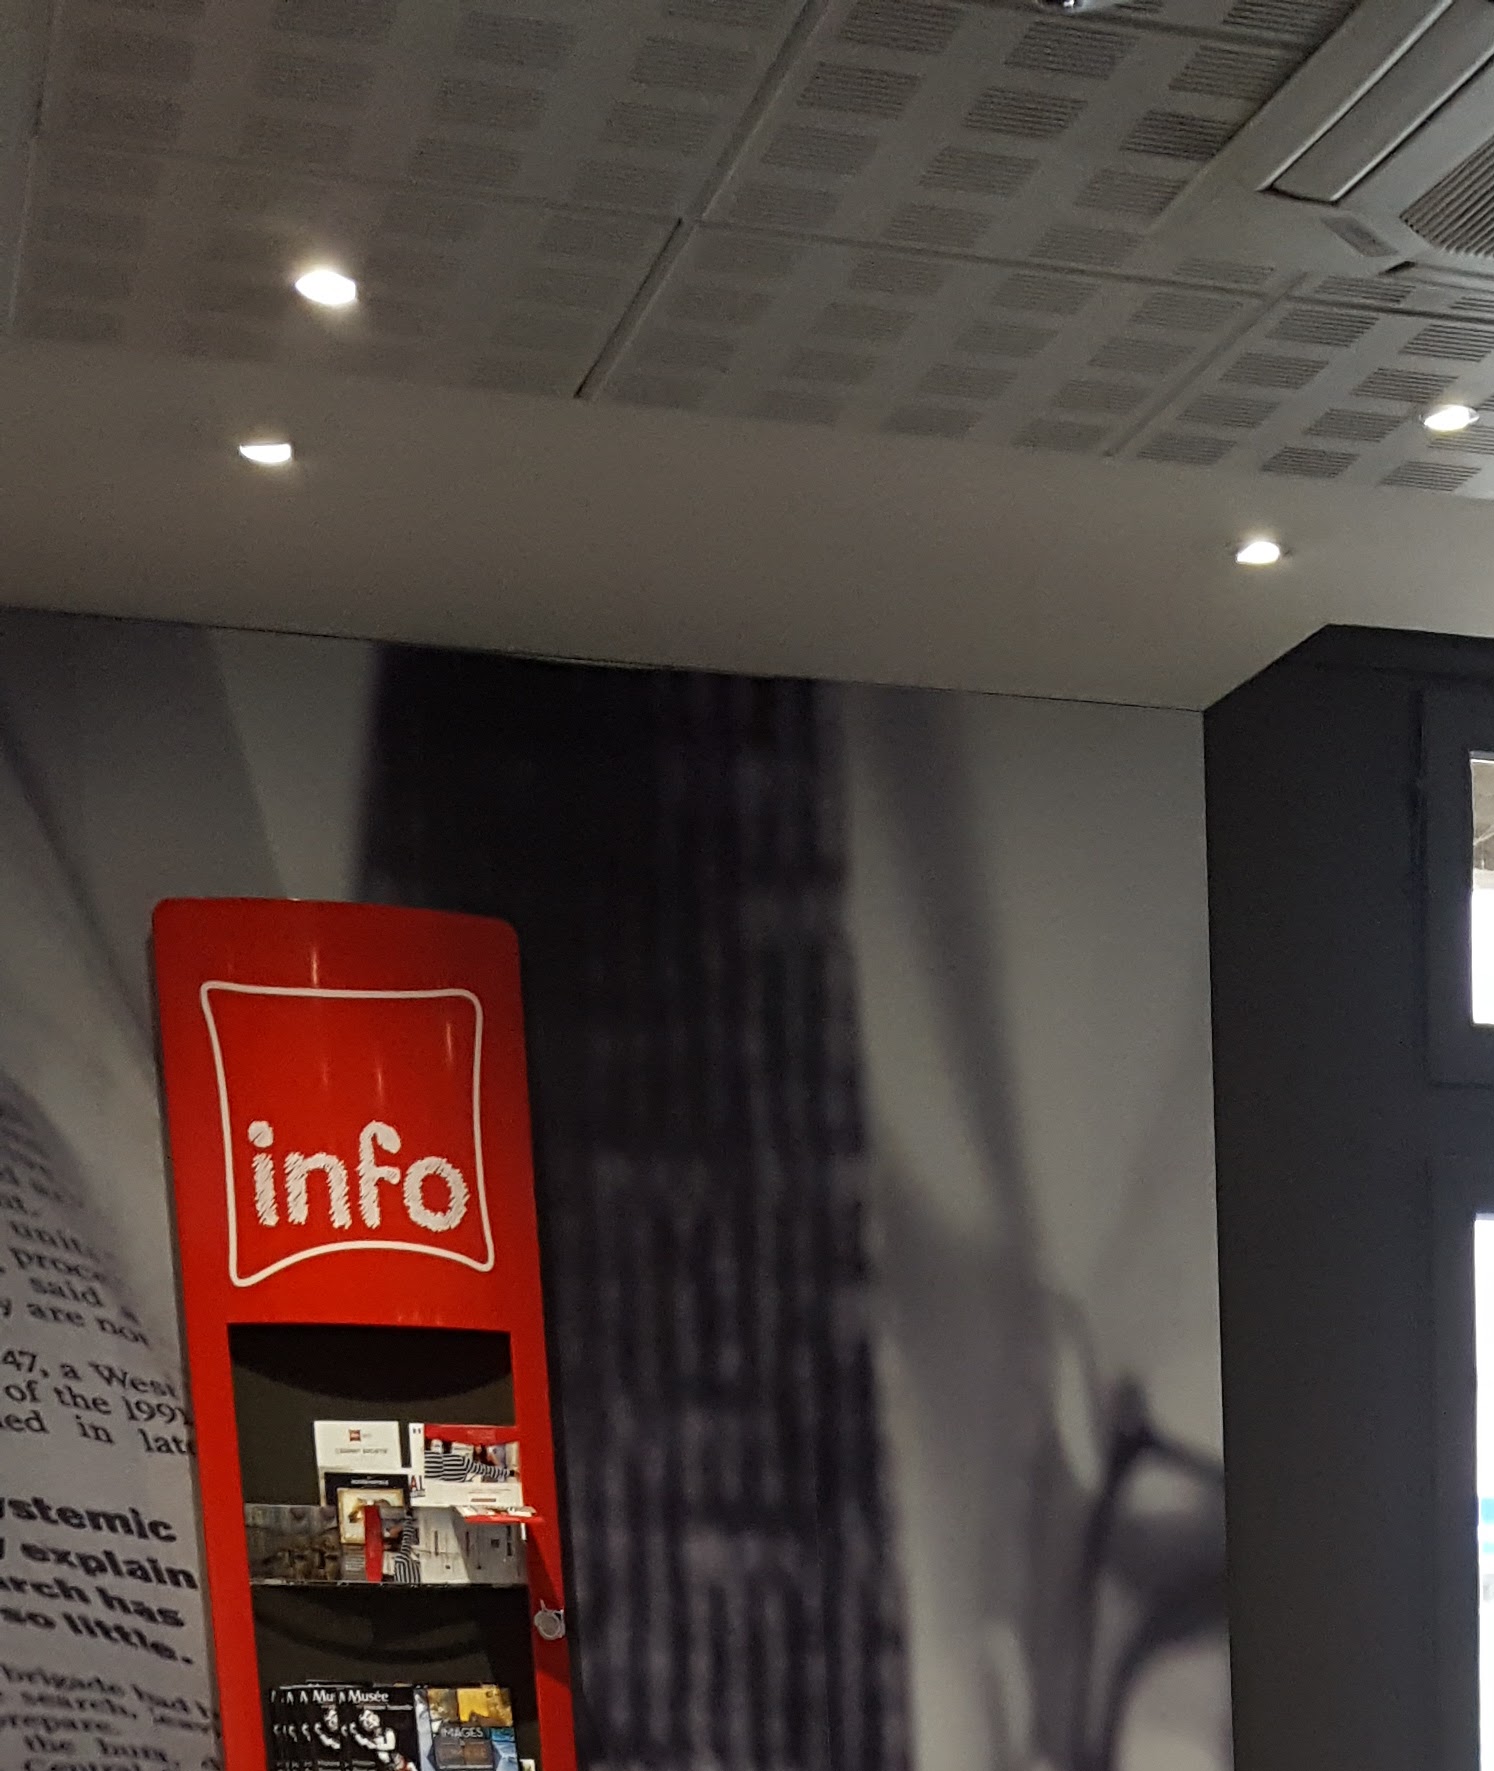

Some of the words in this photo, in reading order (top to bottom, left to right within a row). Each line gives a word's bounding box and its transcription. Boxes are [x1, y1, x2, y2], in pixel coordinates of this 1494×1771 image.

[247, 1119, 471, 1232] info
[26, 1302, 86, 1327] are
[60, 1362, 81, 1381] a
[5, 1379, 39, 1403] of
[54, 1384, 112, 1416] the
[0, 1409, 49, 1434] ed
[75, 1413, 114, 1445] in
[20, 1543, 199, 1590] explain
[95, 1585, 185, 1628] has
[62, 1611, 194, 1665] little.
[348, 1690, 389, 1704] Musée
